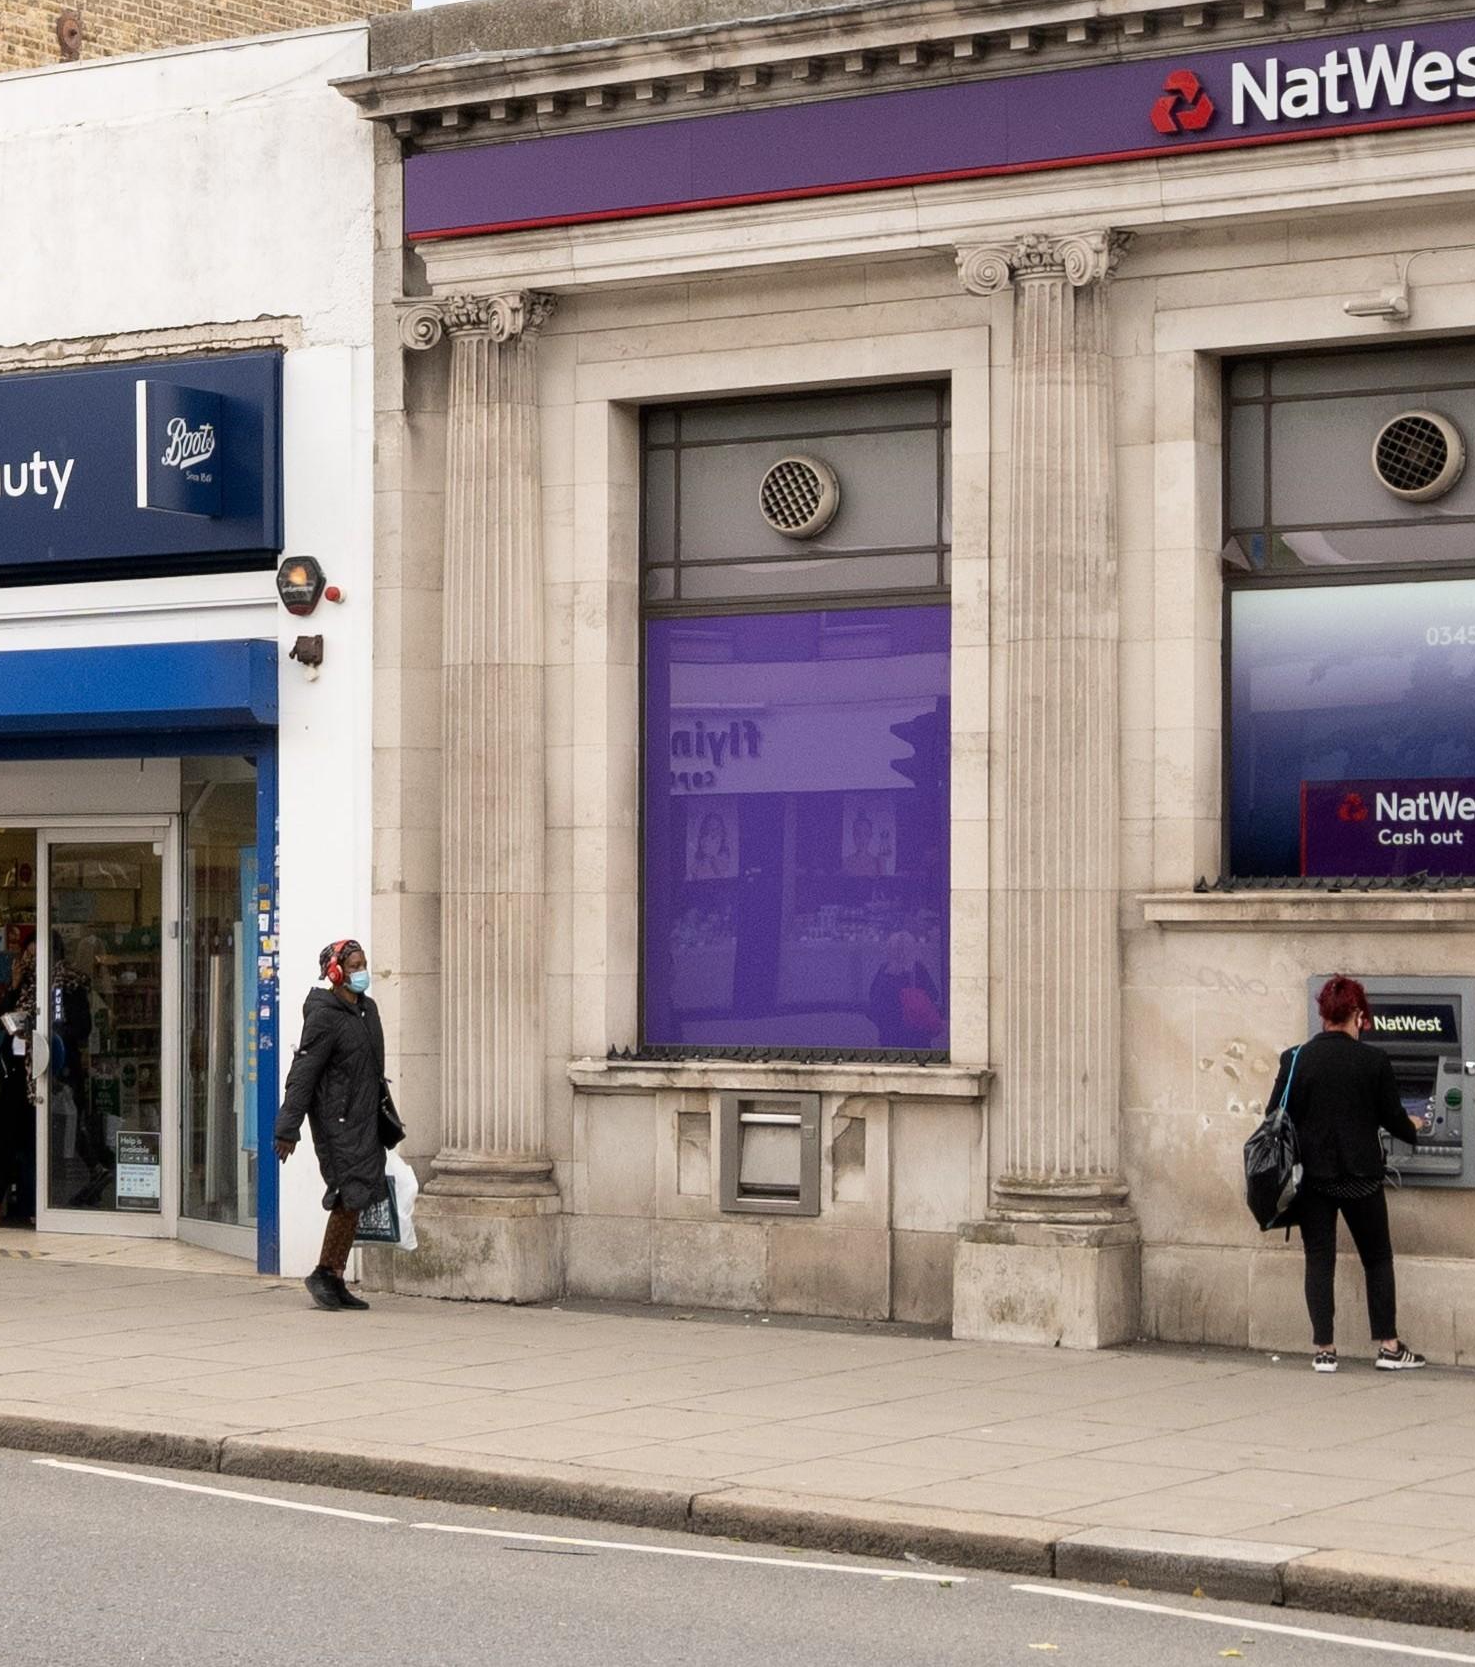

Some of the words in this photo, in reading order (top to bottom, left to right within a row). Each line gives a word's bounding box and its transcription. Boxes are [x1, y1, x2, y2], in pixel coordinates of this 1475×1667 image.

[161, 417, 216, 470] Boots
[1378, 829, 1425, 845] Cash
[1430, 829, 1464, 845] out
[1373, 1015, 1442, 1031] NatWest
